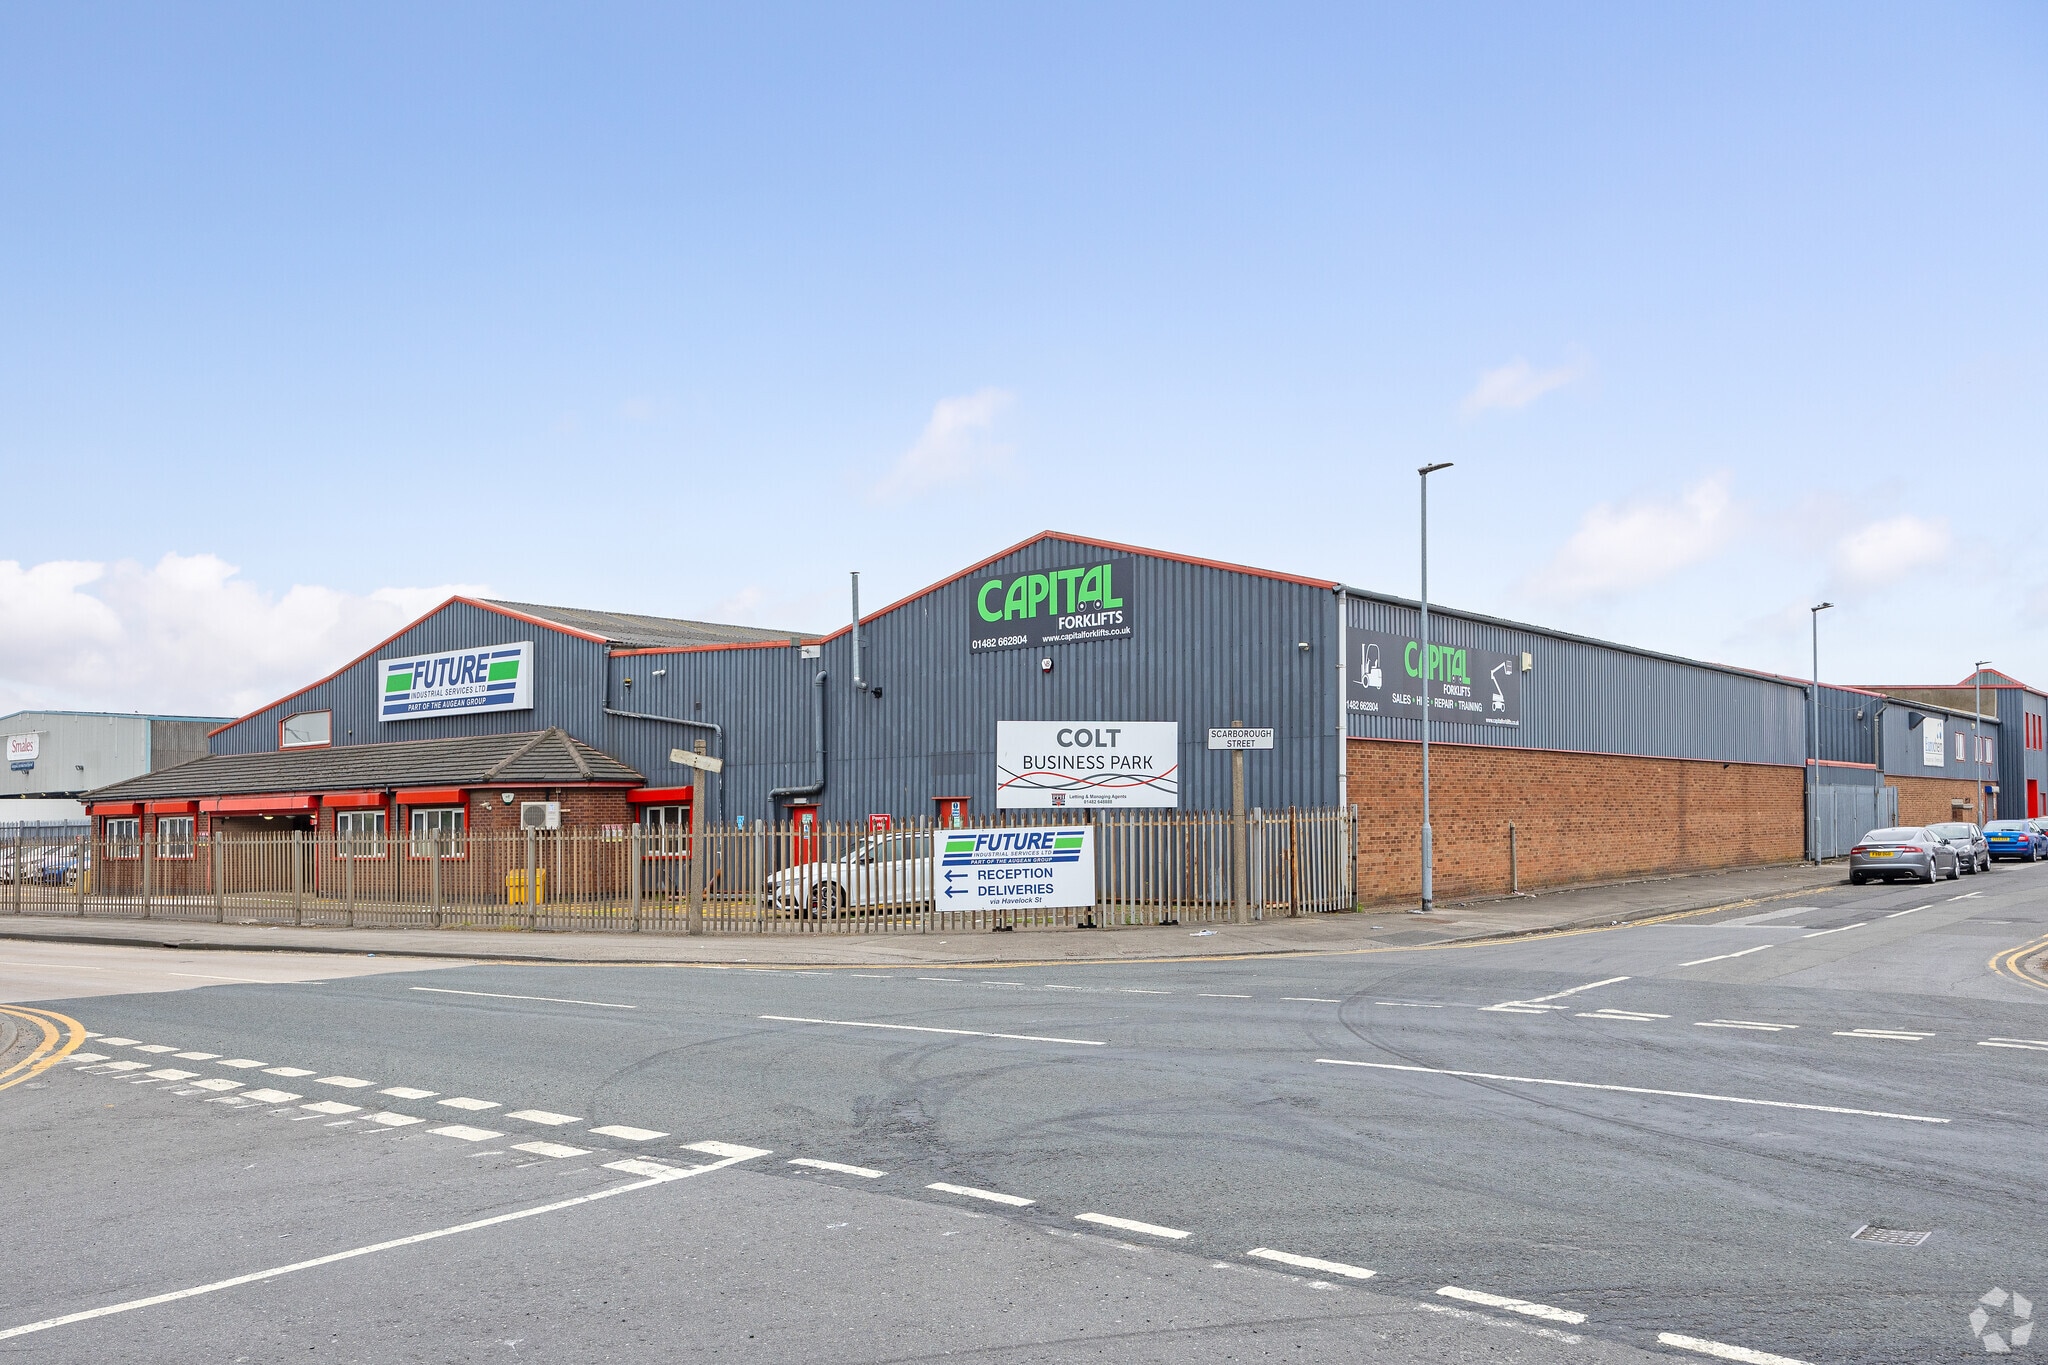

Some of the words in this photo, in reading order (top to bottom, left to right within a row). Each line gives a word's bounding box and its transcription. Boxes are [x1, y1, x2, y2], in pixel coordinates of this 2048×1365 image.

[978, 564, 1123, 622] CAPITAL
[1058, 610, 1124, 630] FORKLIFTS
[1042, 626, 1130, 643] www.capitalforklifts.co.uk
[972, 638, 996, 649] 01482
[998, 635, 1028, 646] 662804
[412, 653, 490, 689] FUTURE
[411, 690, 443, 699] INDUSTRIAL
[445, 686, 473, 696] SERVICES
[1444, 684, 1471, 698] FORKLIFTS
[442, 700, 465, 708] AUGEAN
[466, 697, 486, 706] GROUP
[1360, 701, 1378, 712] 662804
[1392, 693, 1411, 705] SALES
[1416, 696, 1430, 706] HIE
[1434, 698, 1454, 709] REPAIR
[1458, 700, 1482, 712] TRAINING
[12, 738, 33, 752] Smales
[1056, 728, 1121, 748] COLT
[1023, 756, 1104, 770] BUSINESS
[1111, 756, 1153, 770] PARK
[975, 832, 1055, 851] FUTURE
[978, 868, 1053, 880] RECEPTION
[978, 884, 1054, 896] DELIVERIES
